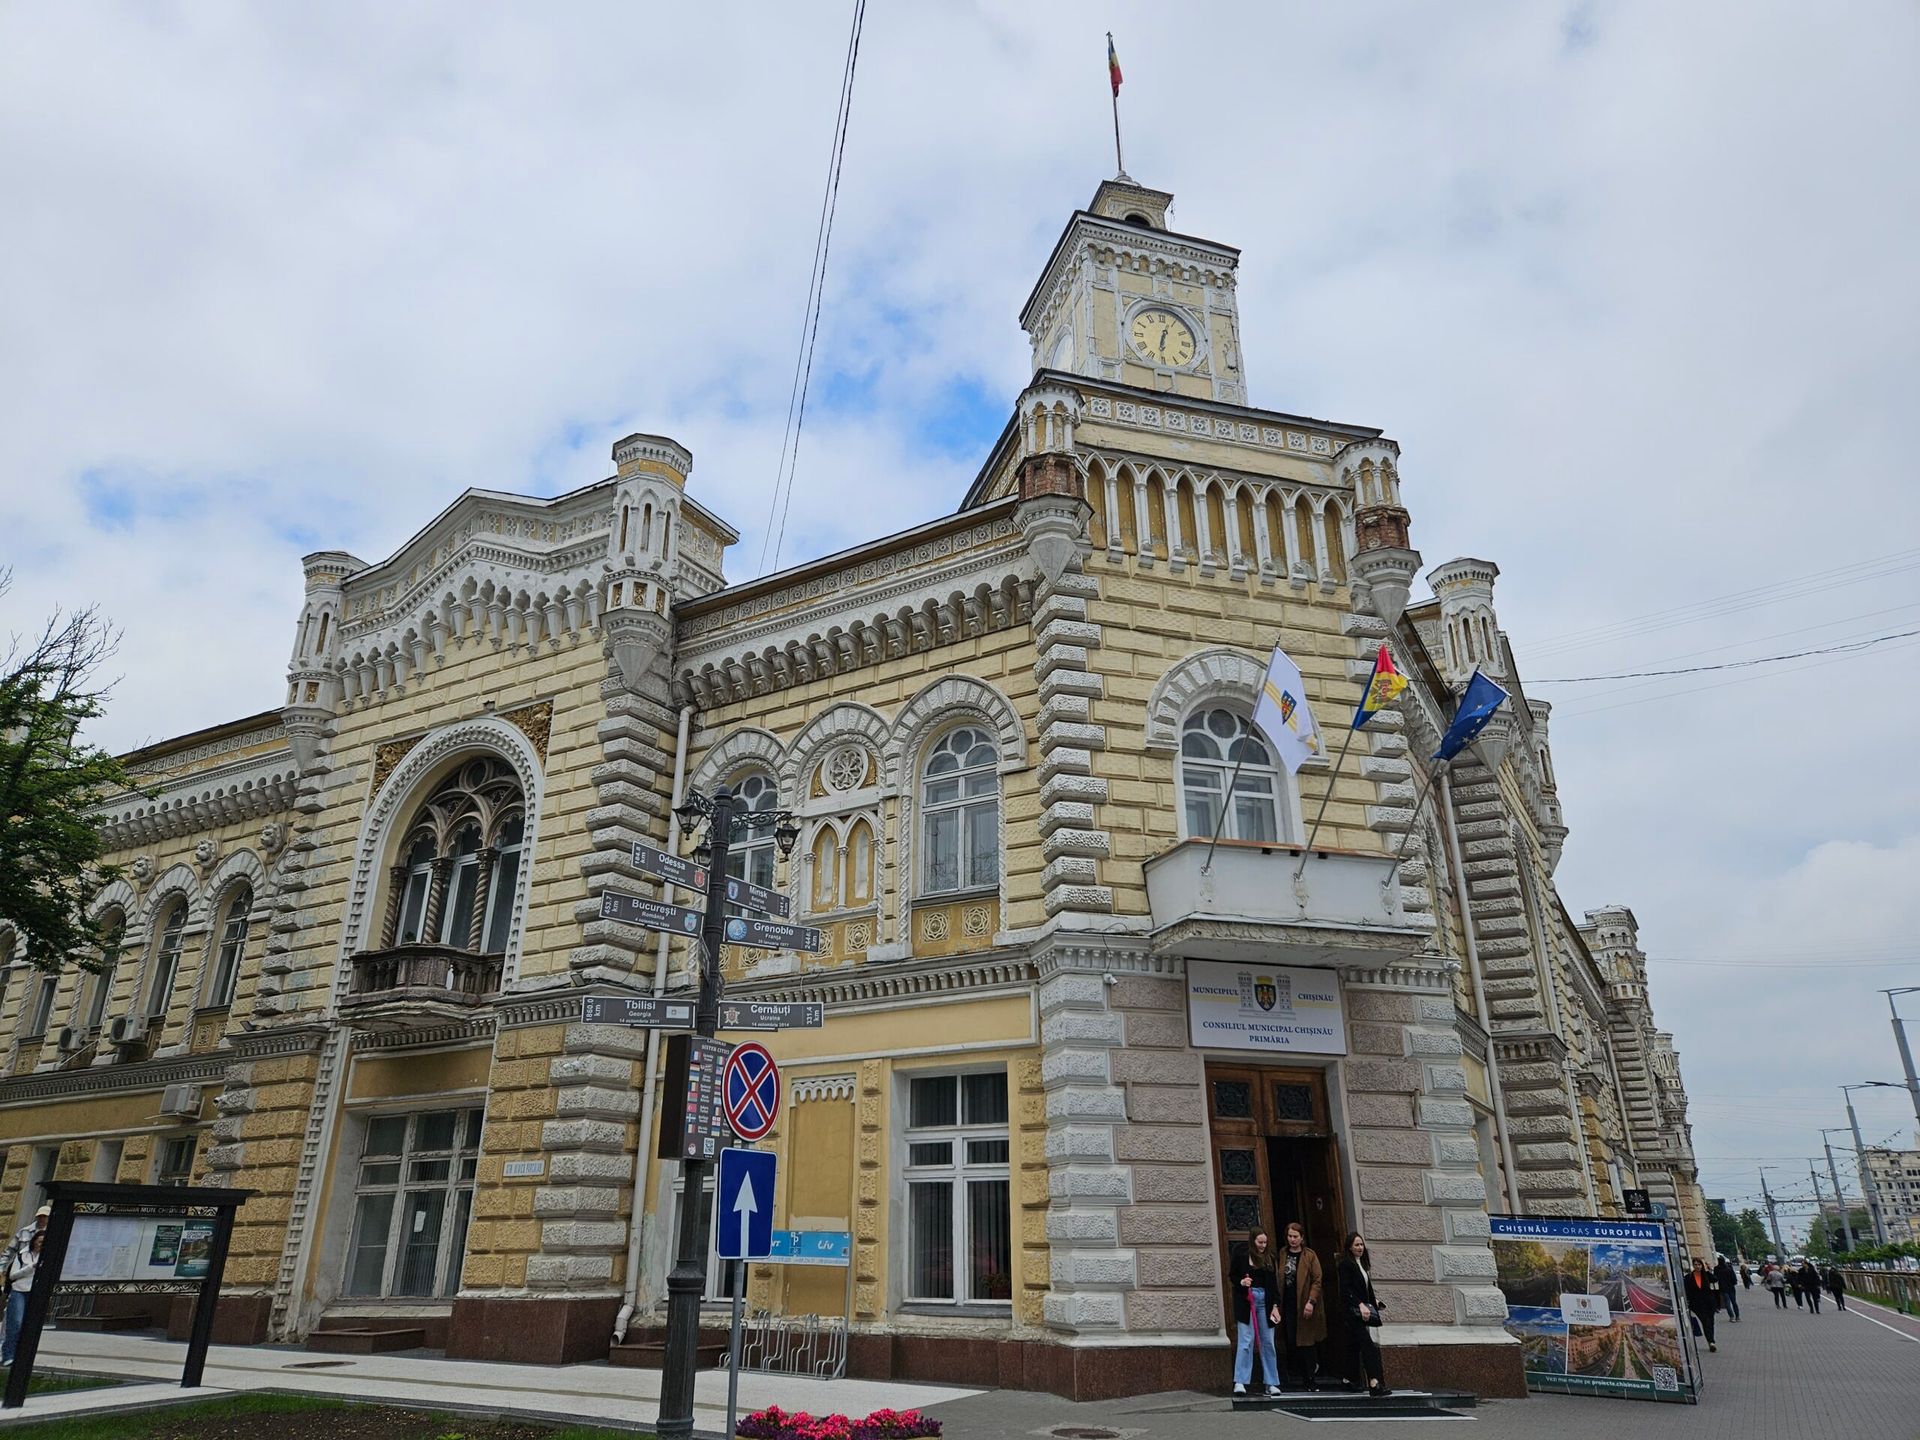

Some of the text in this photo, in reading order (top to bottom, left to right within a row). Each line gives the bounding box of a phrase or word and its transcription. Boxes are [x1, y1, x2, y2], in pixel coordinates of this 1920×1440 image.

[640, 852, 646, 864] km
[659, 854, 685, 870] Odessa
[750, 886, 767, 898] Minsk
[612, 900, 619, 912] km
[632, 900, 676, 916] București
[754, 923, 793, 935] Grenoble
[812, 936, 817, 946] km
[1193, 986, 1333, 1002] MUNICIPIUL CHIȘINĂU
[594, 1005, 600, 1016] km
[625, 1000, 655, 1010] Tbilisi
[751, 1005, 790, 1016] Cernăuți
[813, 1010, 819, 1021] km
[1203, 1021, 1333, 1036] CONSILIUL MUNICIPAL CHIȘINĂU
[1249, 1034, 1290, 1044] PRIMĂRIA
[1499, 1224, 1548, 1233] CHIȘINĂU
[1595, 1228, 1652, 1237] EUROPEAN
[818, 1241, 834, 1250] Liv
